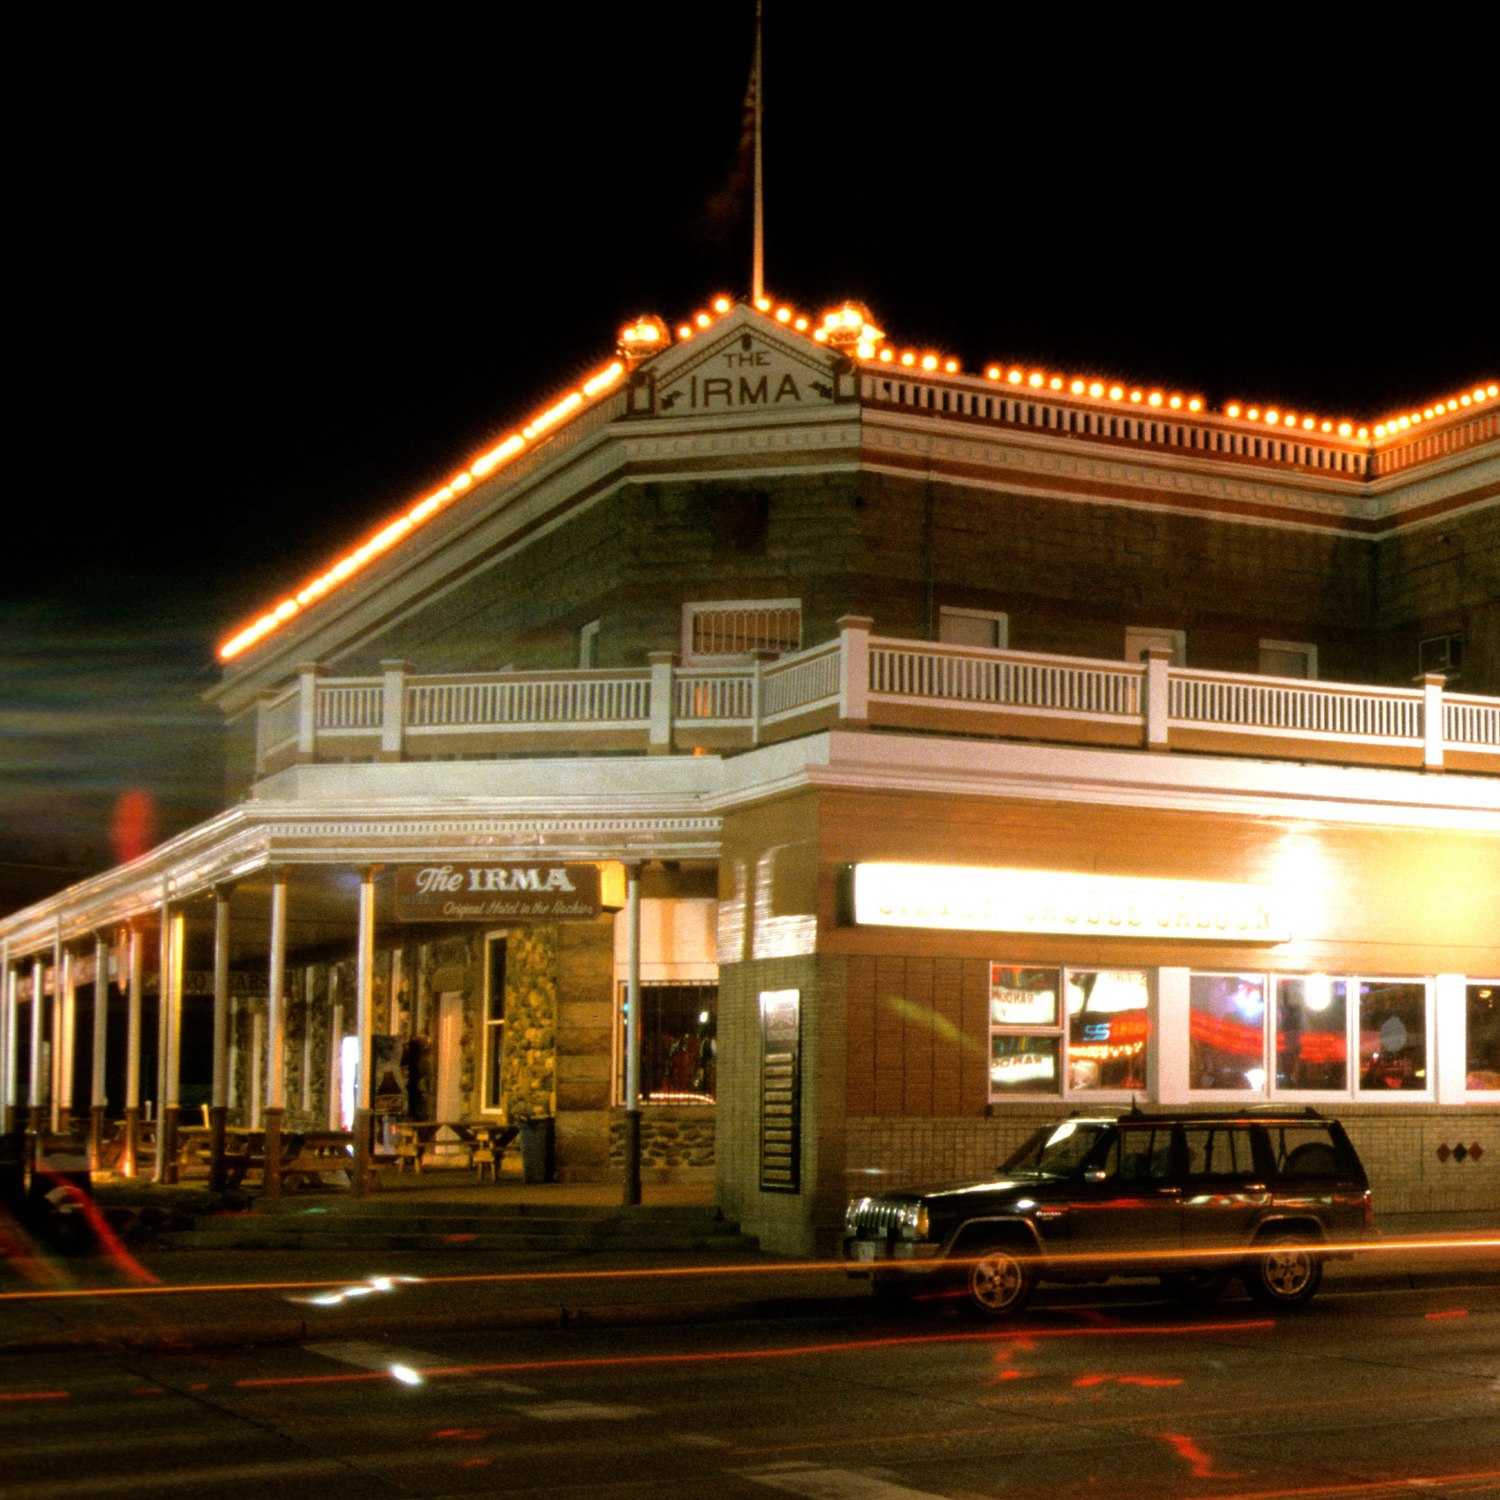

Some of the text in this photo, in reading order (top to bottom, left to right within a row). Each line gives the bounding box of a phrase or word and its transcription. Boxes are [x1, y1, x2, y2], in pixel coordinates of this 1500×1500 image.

[722, 351, 771, 369] THE
[690, 373, 803, 408] IRMA
[416, 864, 577, 894] The IRMA
[443, 901, 486, 918] Original
